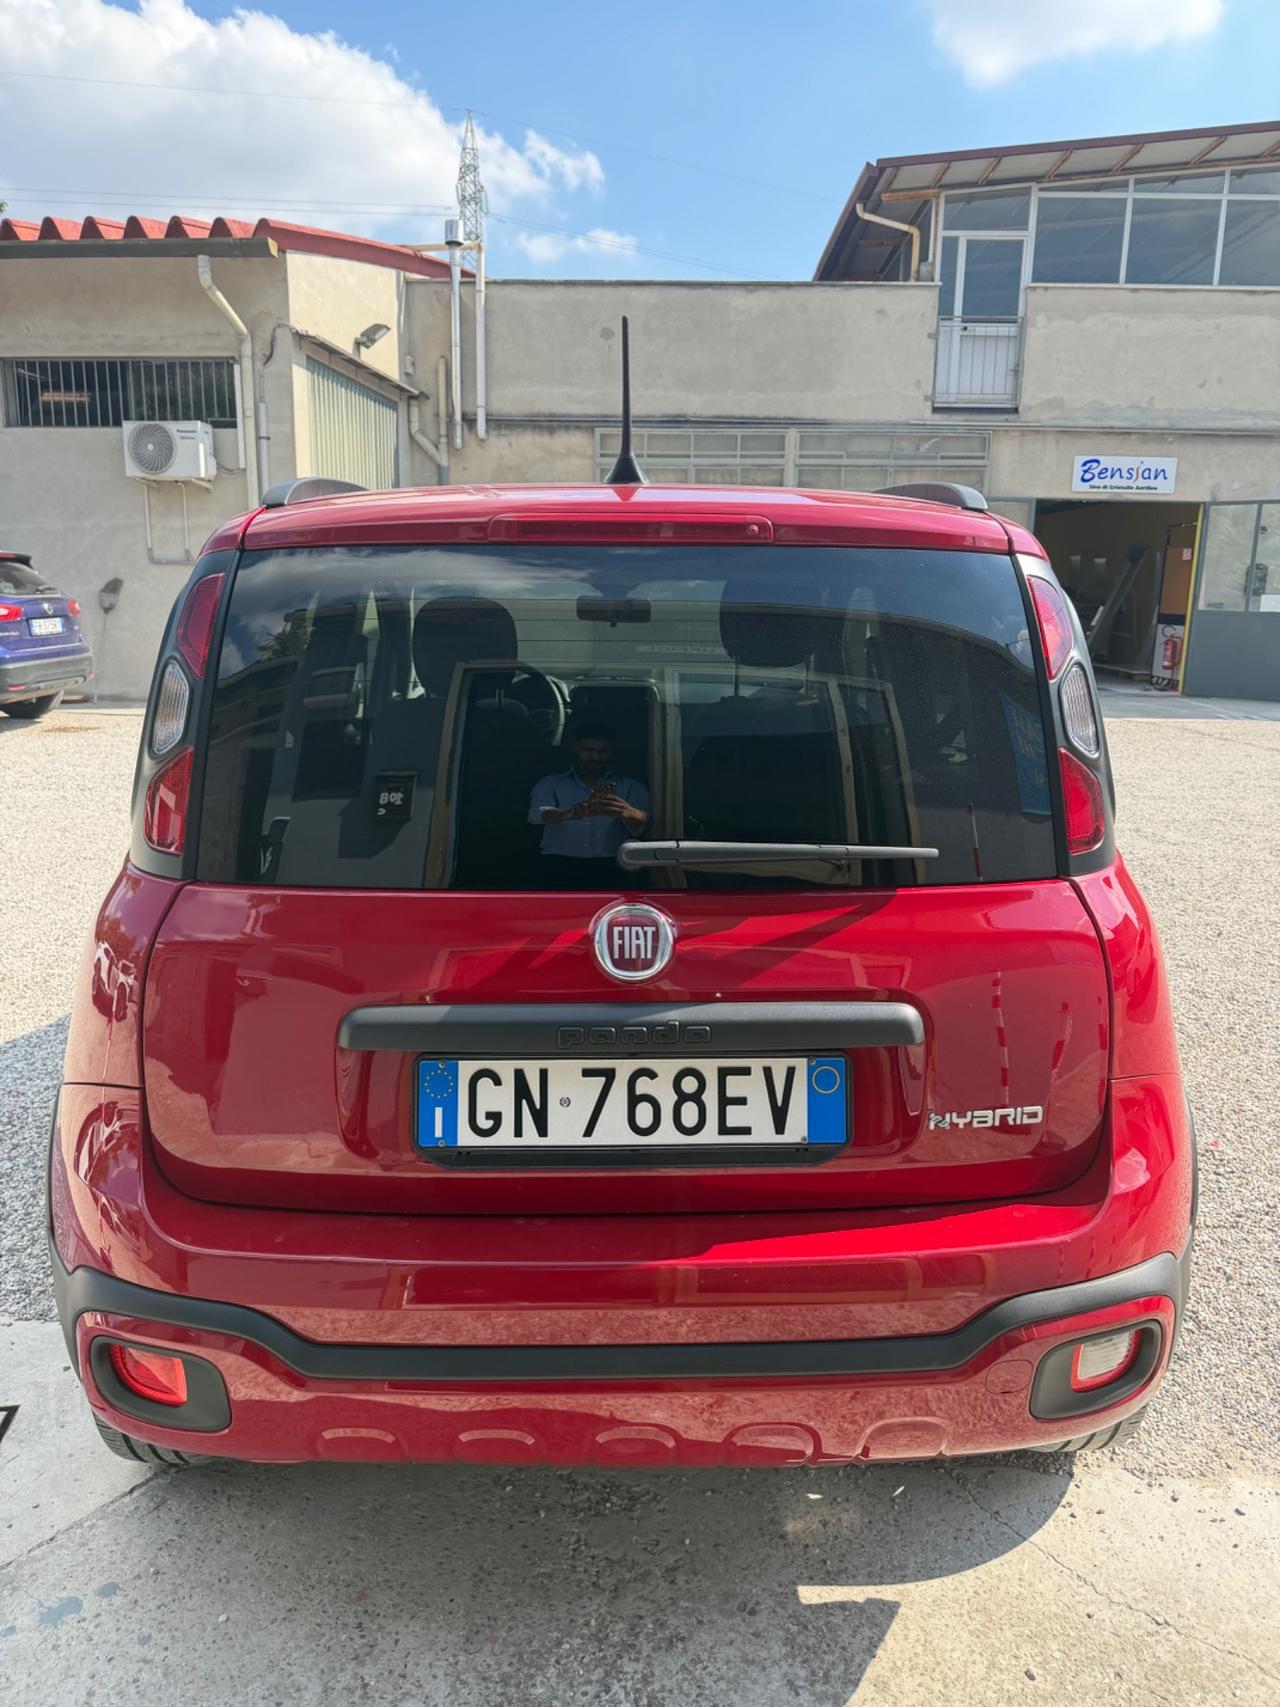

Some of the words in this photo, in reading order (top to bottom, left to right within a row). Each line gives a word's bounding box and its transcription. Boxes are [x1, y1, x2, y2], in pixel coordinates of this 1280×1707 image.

[612, 926, 656, 960] FIAT
[557, 1020, 711, 1049] panda
[928, 1105, 1044, 1131] HYBRID
